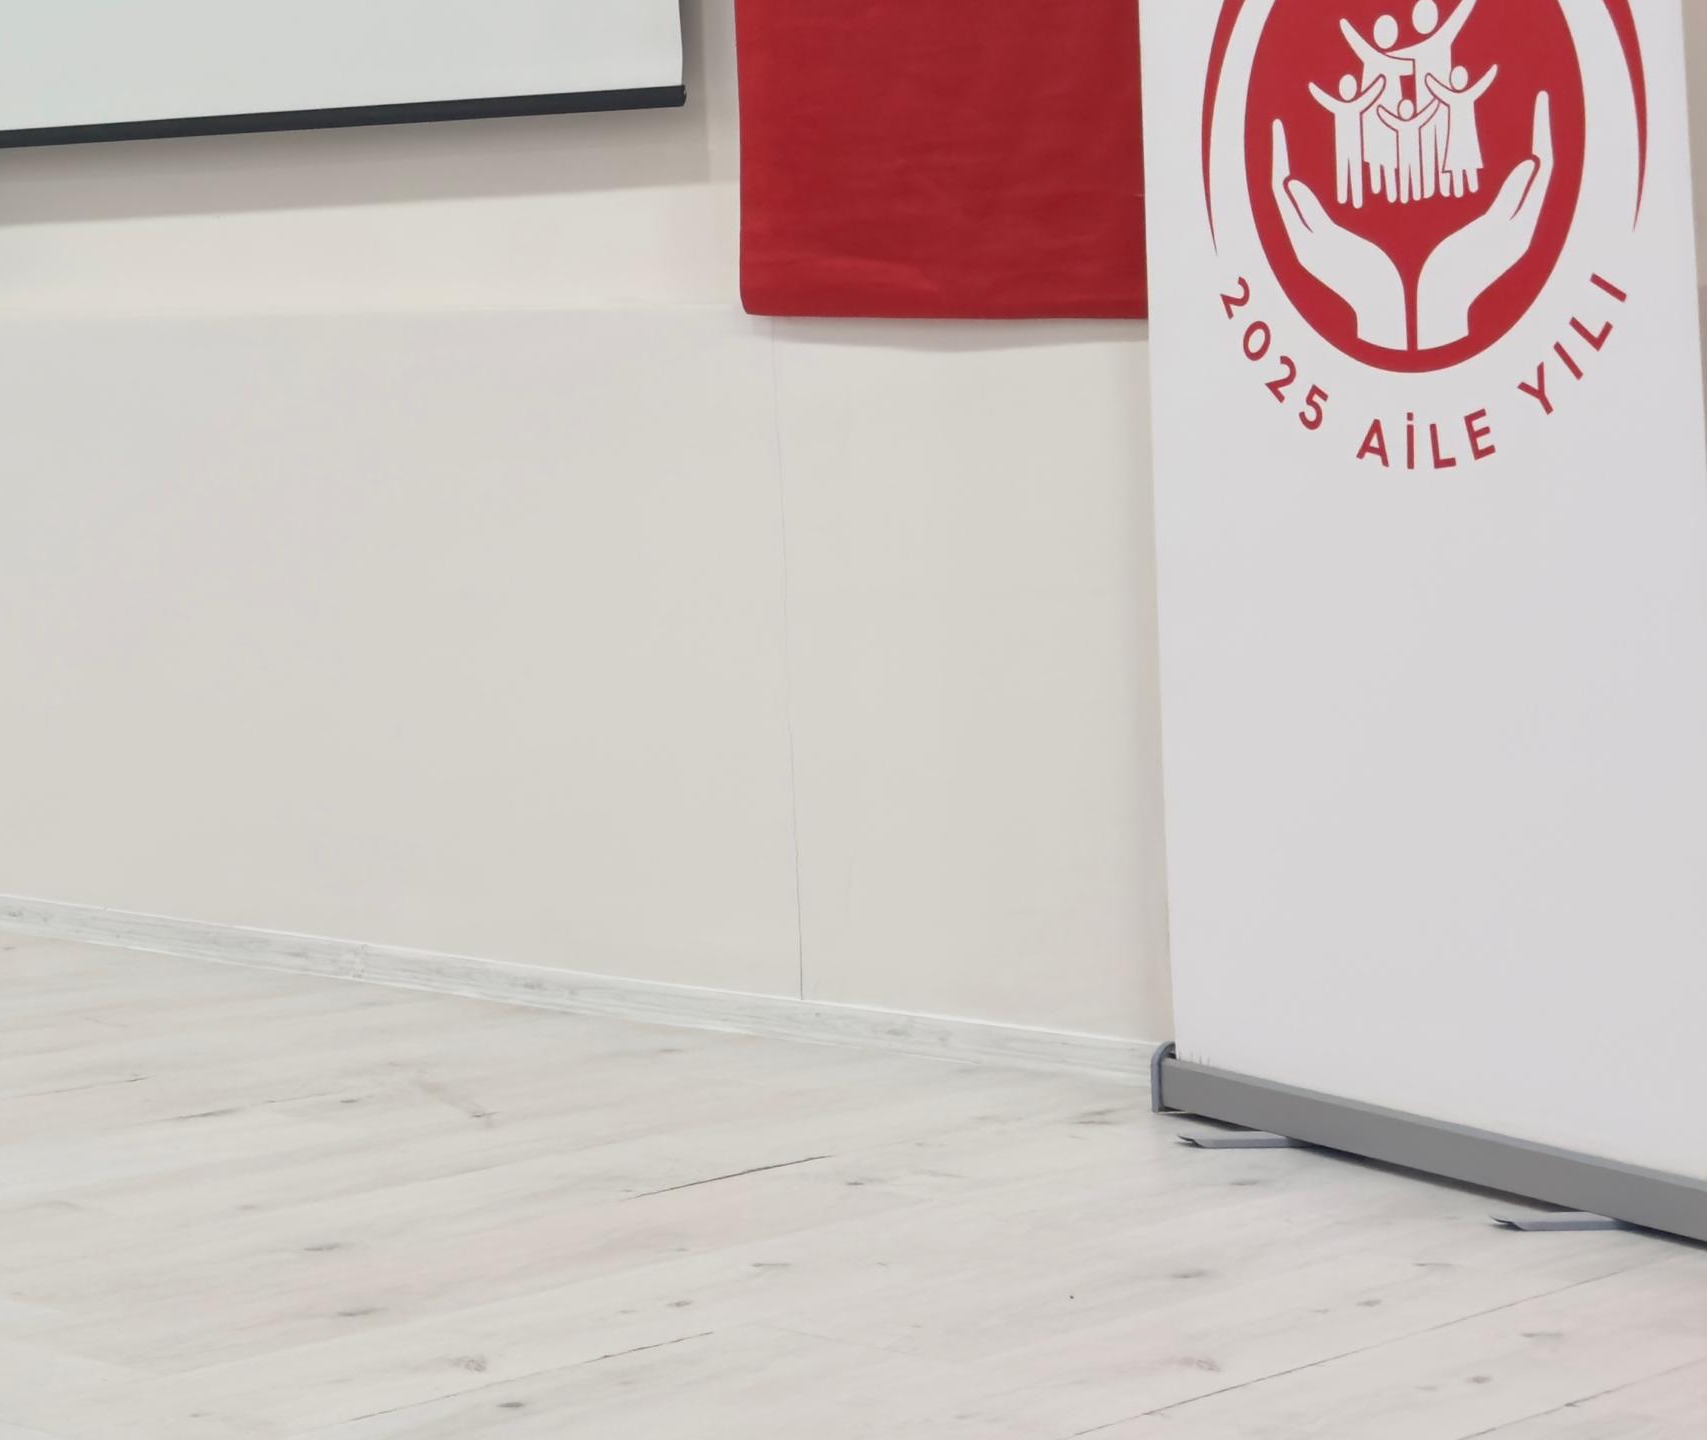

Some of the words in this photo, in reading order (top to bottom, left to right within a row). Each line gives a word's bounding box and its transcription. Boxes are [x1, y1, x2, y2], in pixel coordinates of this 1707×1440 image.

[1220, 276, 1329, 431] 2025
[1356, 407, 1496, 470] AİLE
[1517, 272, 1628, 415] YILI
